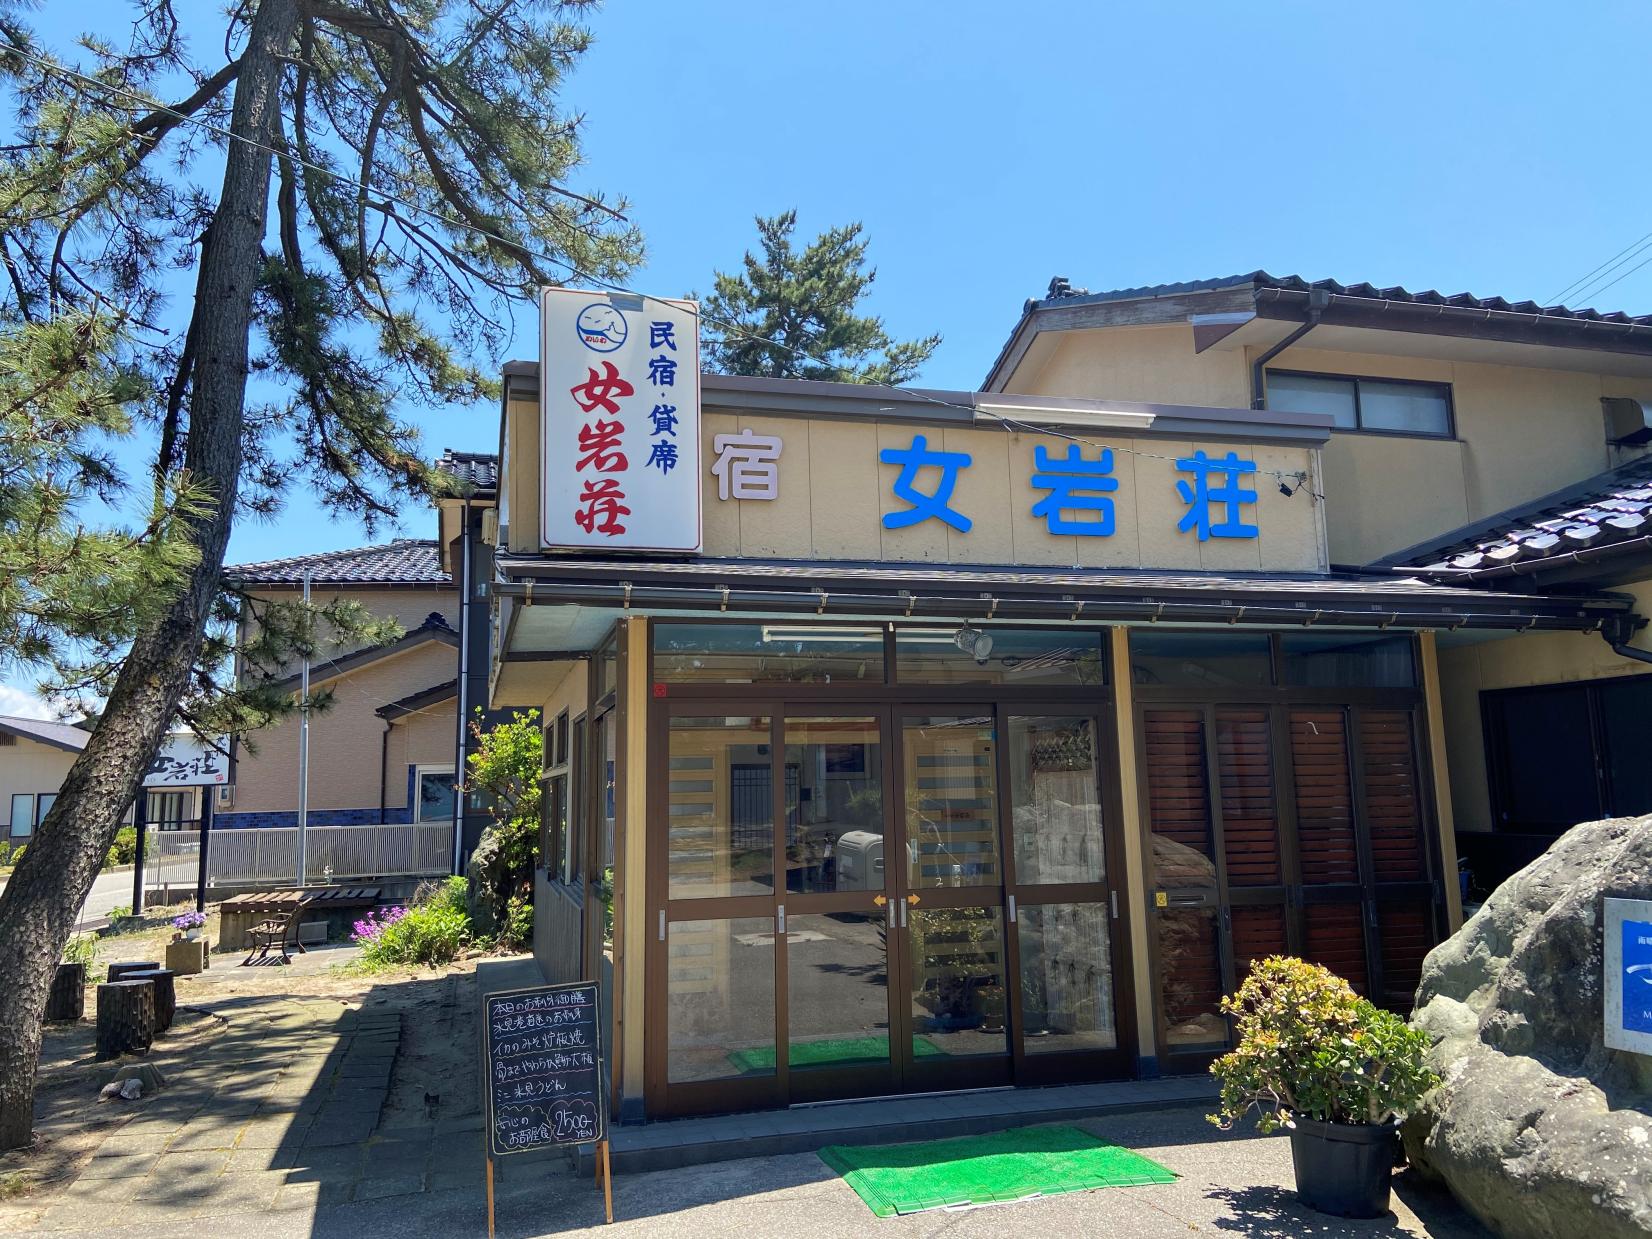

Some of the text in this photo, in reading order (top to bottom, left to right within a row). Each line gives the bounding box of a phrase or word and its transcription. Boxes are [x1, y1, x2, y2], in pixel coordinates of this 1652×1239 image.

[570, 360, 635, 537] 女岩荘
[711, 428, 1259, 542] 宿 女岩荘
